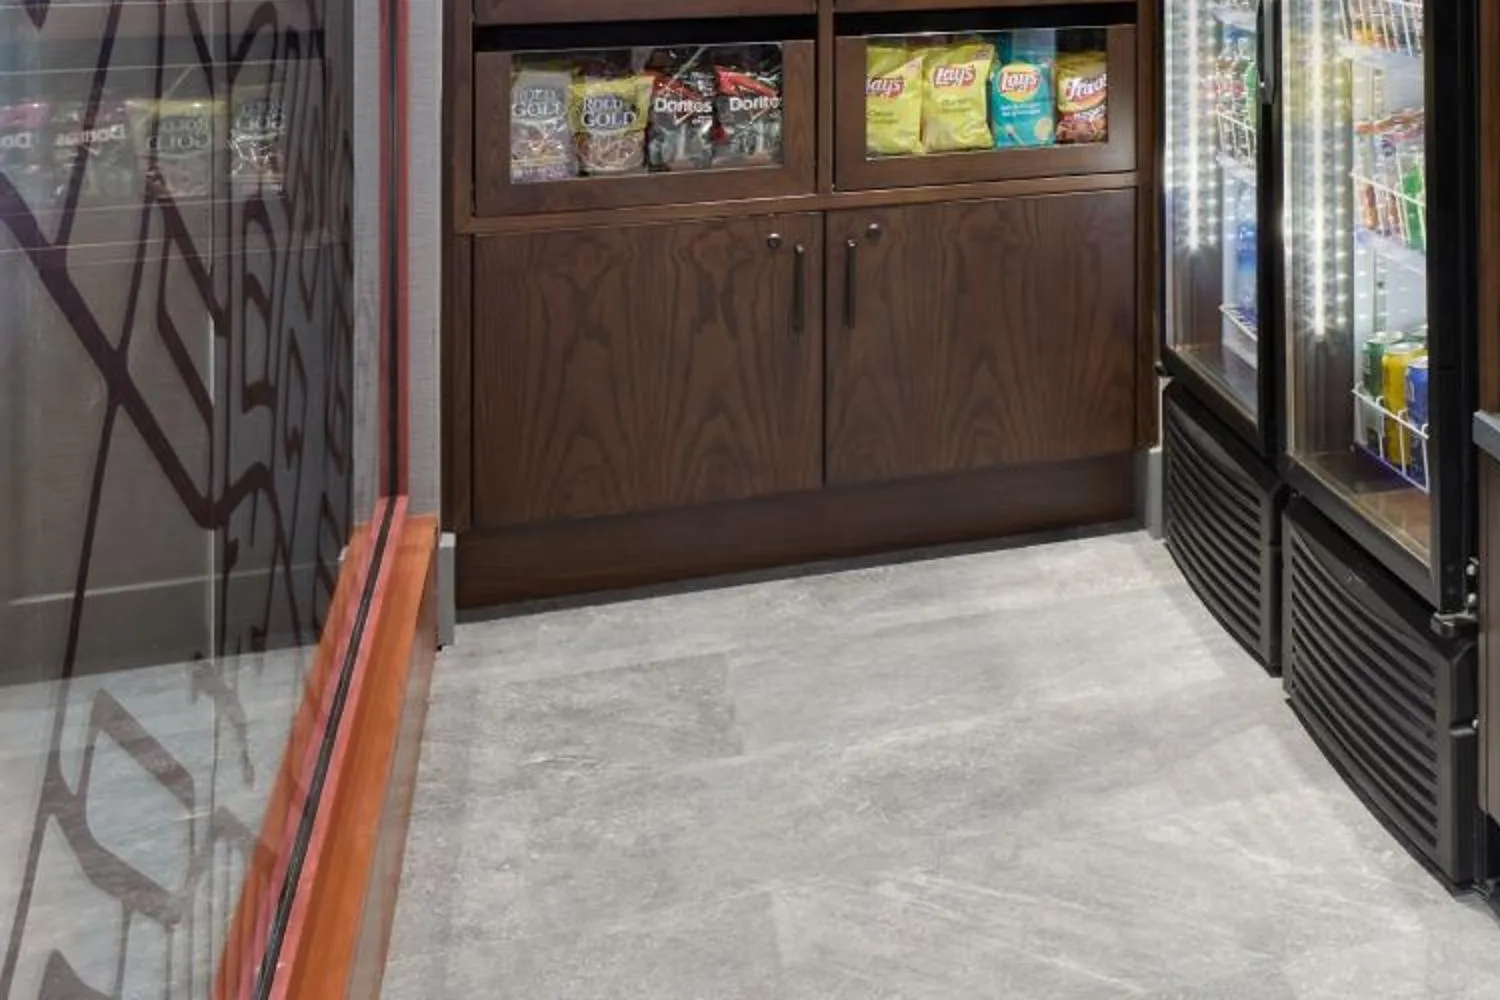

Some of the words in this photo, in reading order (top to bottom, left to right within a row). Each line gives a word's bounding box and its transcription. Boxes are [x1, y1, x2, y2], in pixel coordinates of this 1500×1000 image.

[655, 97, 713, 113] Doritos
[730, 95, 782, 112] Dorito
[582, 111, 637, 128] GOLD
